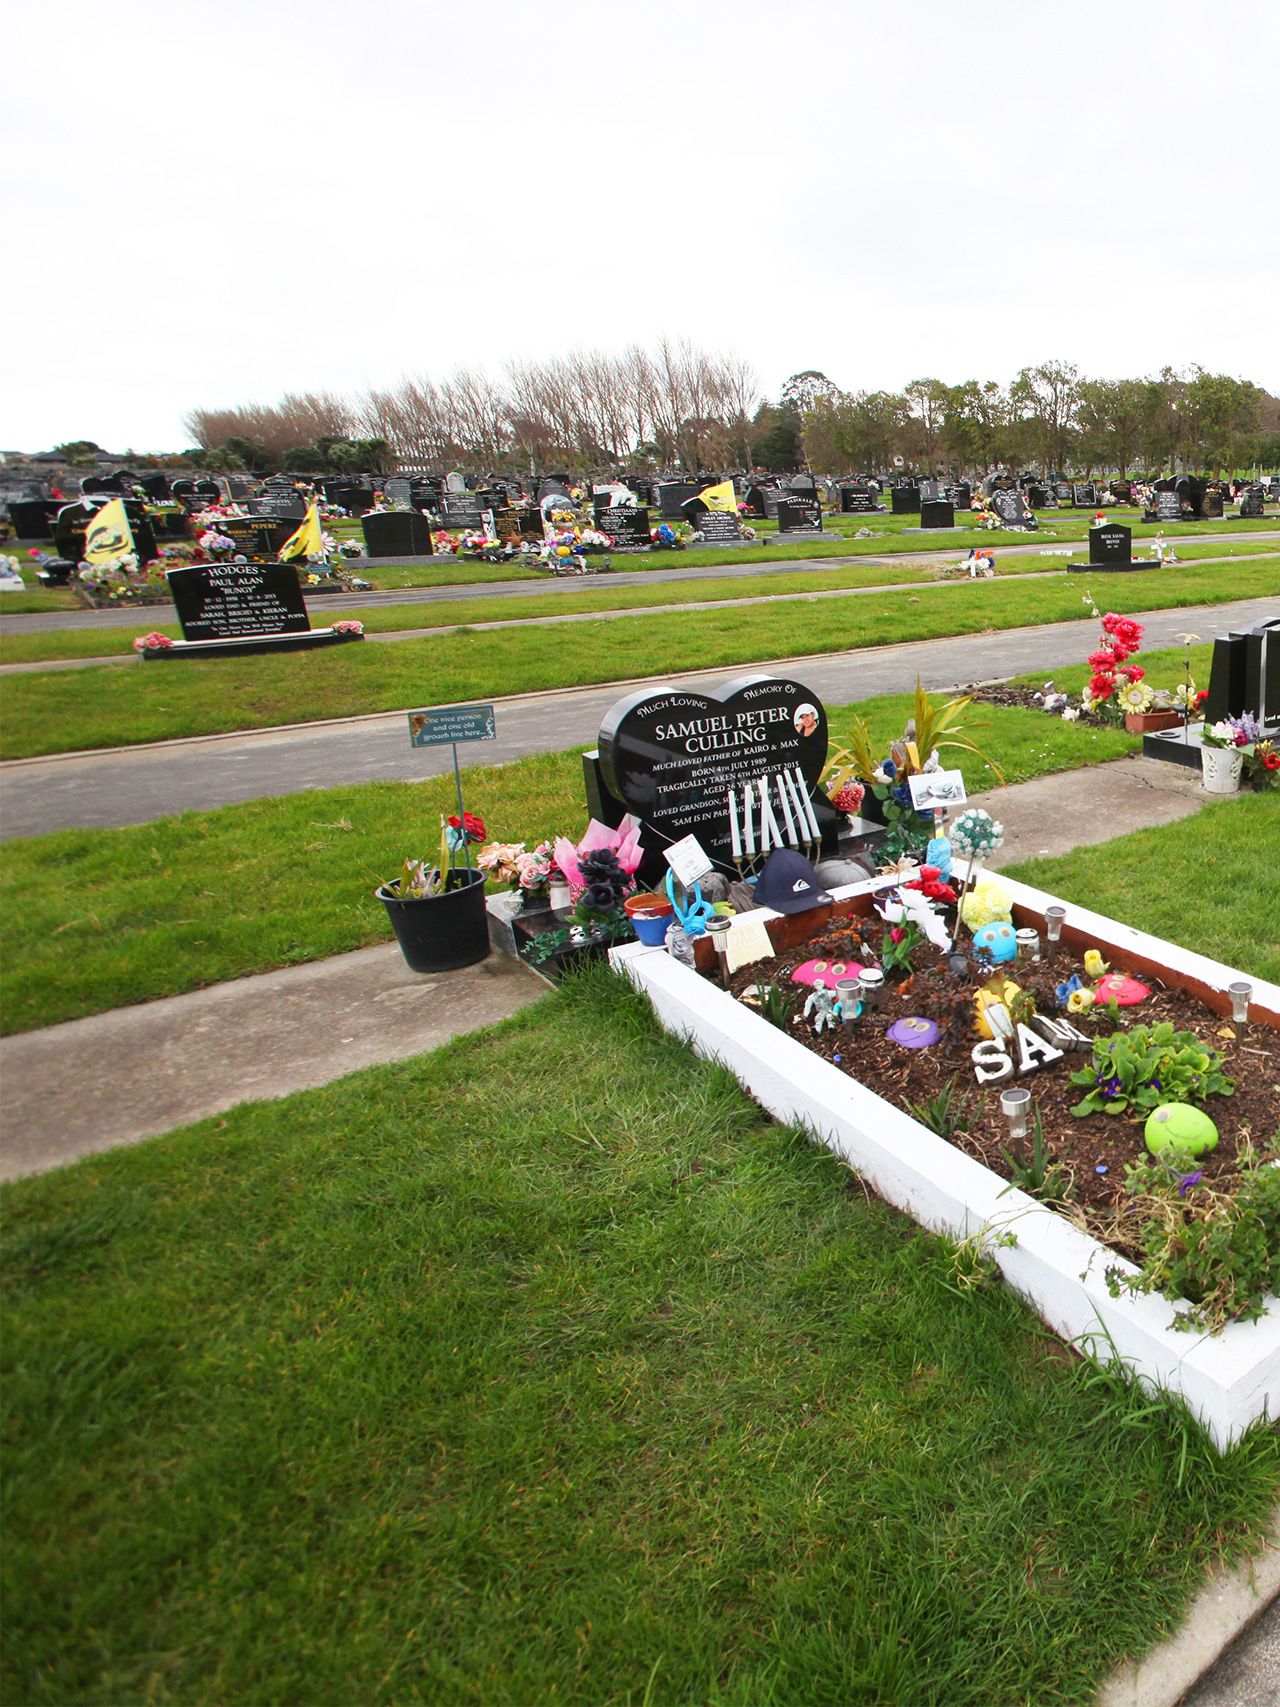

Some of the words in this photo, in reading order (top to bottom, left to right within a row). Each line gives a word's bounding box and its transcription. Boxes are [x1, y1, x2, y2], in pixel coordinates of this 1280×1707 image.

[208, 566, 258, 578] HODGES
[210, 578, 234, 587] PAUL
[238, 577, 264, 585] ALAN
[744, 686, 783, 700] MEMORY
[785, 684, 797, 694] OF
[637, 700, 669, 718] MUCH
[670, 697, 708, 710] LOVING
[655, 716, 732, 741] SAMUEL
[736, 706, 790, 727] PETER
[685, 727, 766, 753] CULLING
[652, 759, 676, 771] MUCH
[678, 756, 702, 767] LOVED
[703, 753, 730, 763] FATHER
[732, 750, 741, 758] OF
[744, 745, 769, 755] KAIRO
[780, 739, 799, 749] MAX
[692, 767, 715, 778] BORN
[717, 764, 730, 772] 4TH
[730, 760, 749, 772] JULY
[751, 758, 767, 766] 1989
[656, 778, 708, 794] TRAGICALLY
[709, 773, 736, 784] TAKEN
[752, 764, 782, 776] AUGUST
[703, 785, 725, 796] AGED
[653, 806, 679, 818] LOVED
[680, 799, 722, 812] GRANDSON,
[672, 815, 692, 826] "SAM
[694, 814, 700, 822] IS
[702, 811, 712, 820] IN
[971, 1014, 1093, 1084] SAM
